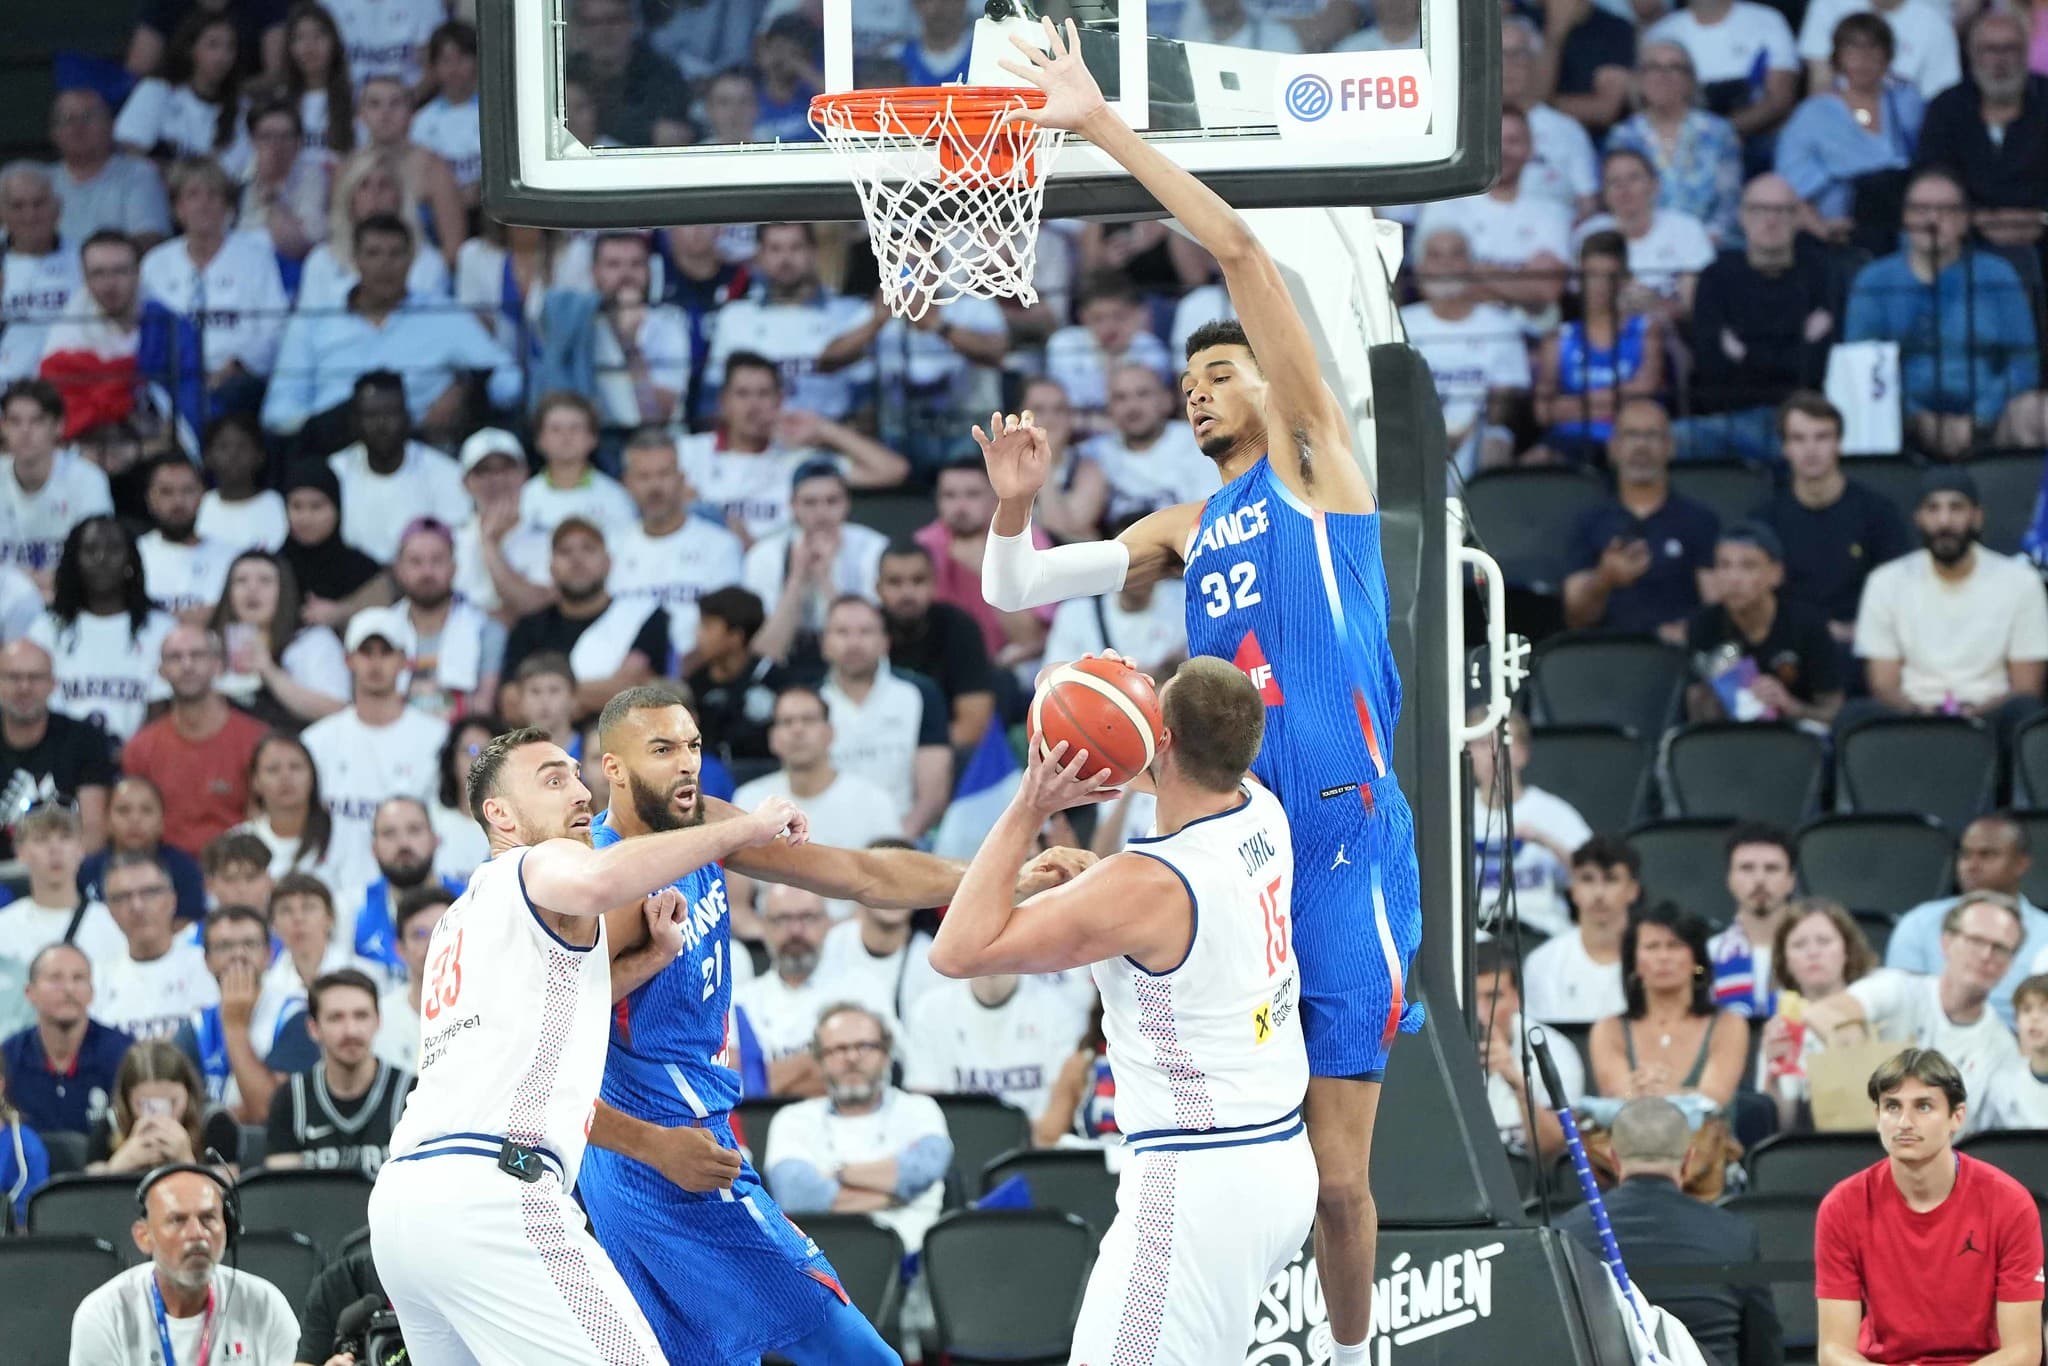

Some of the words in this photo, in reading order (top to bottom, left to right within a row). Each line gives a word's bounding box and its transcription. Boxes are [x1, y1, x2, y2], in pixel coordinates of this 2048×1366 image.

[1340, 75, 1419, 112] FFBB
[1188, 497, 1269, 564] ANCE
[1200, 560, 1262, 619] 32
[1259, 875, 1287, 978] 15
[425, 927, 464, 1021] 33
[702, 939, 722, 1002] 21
